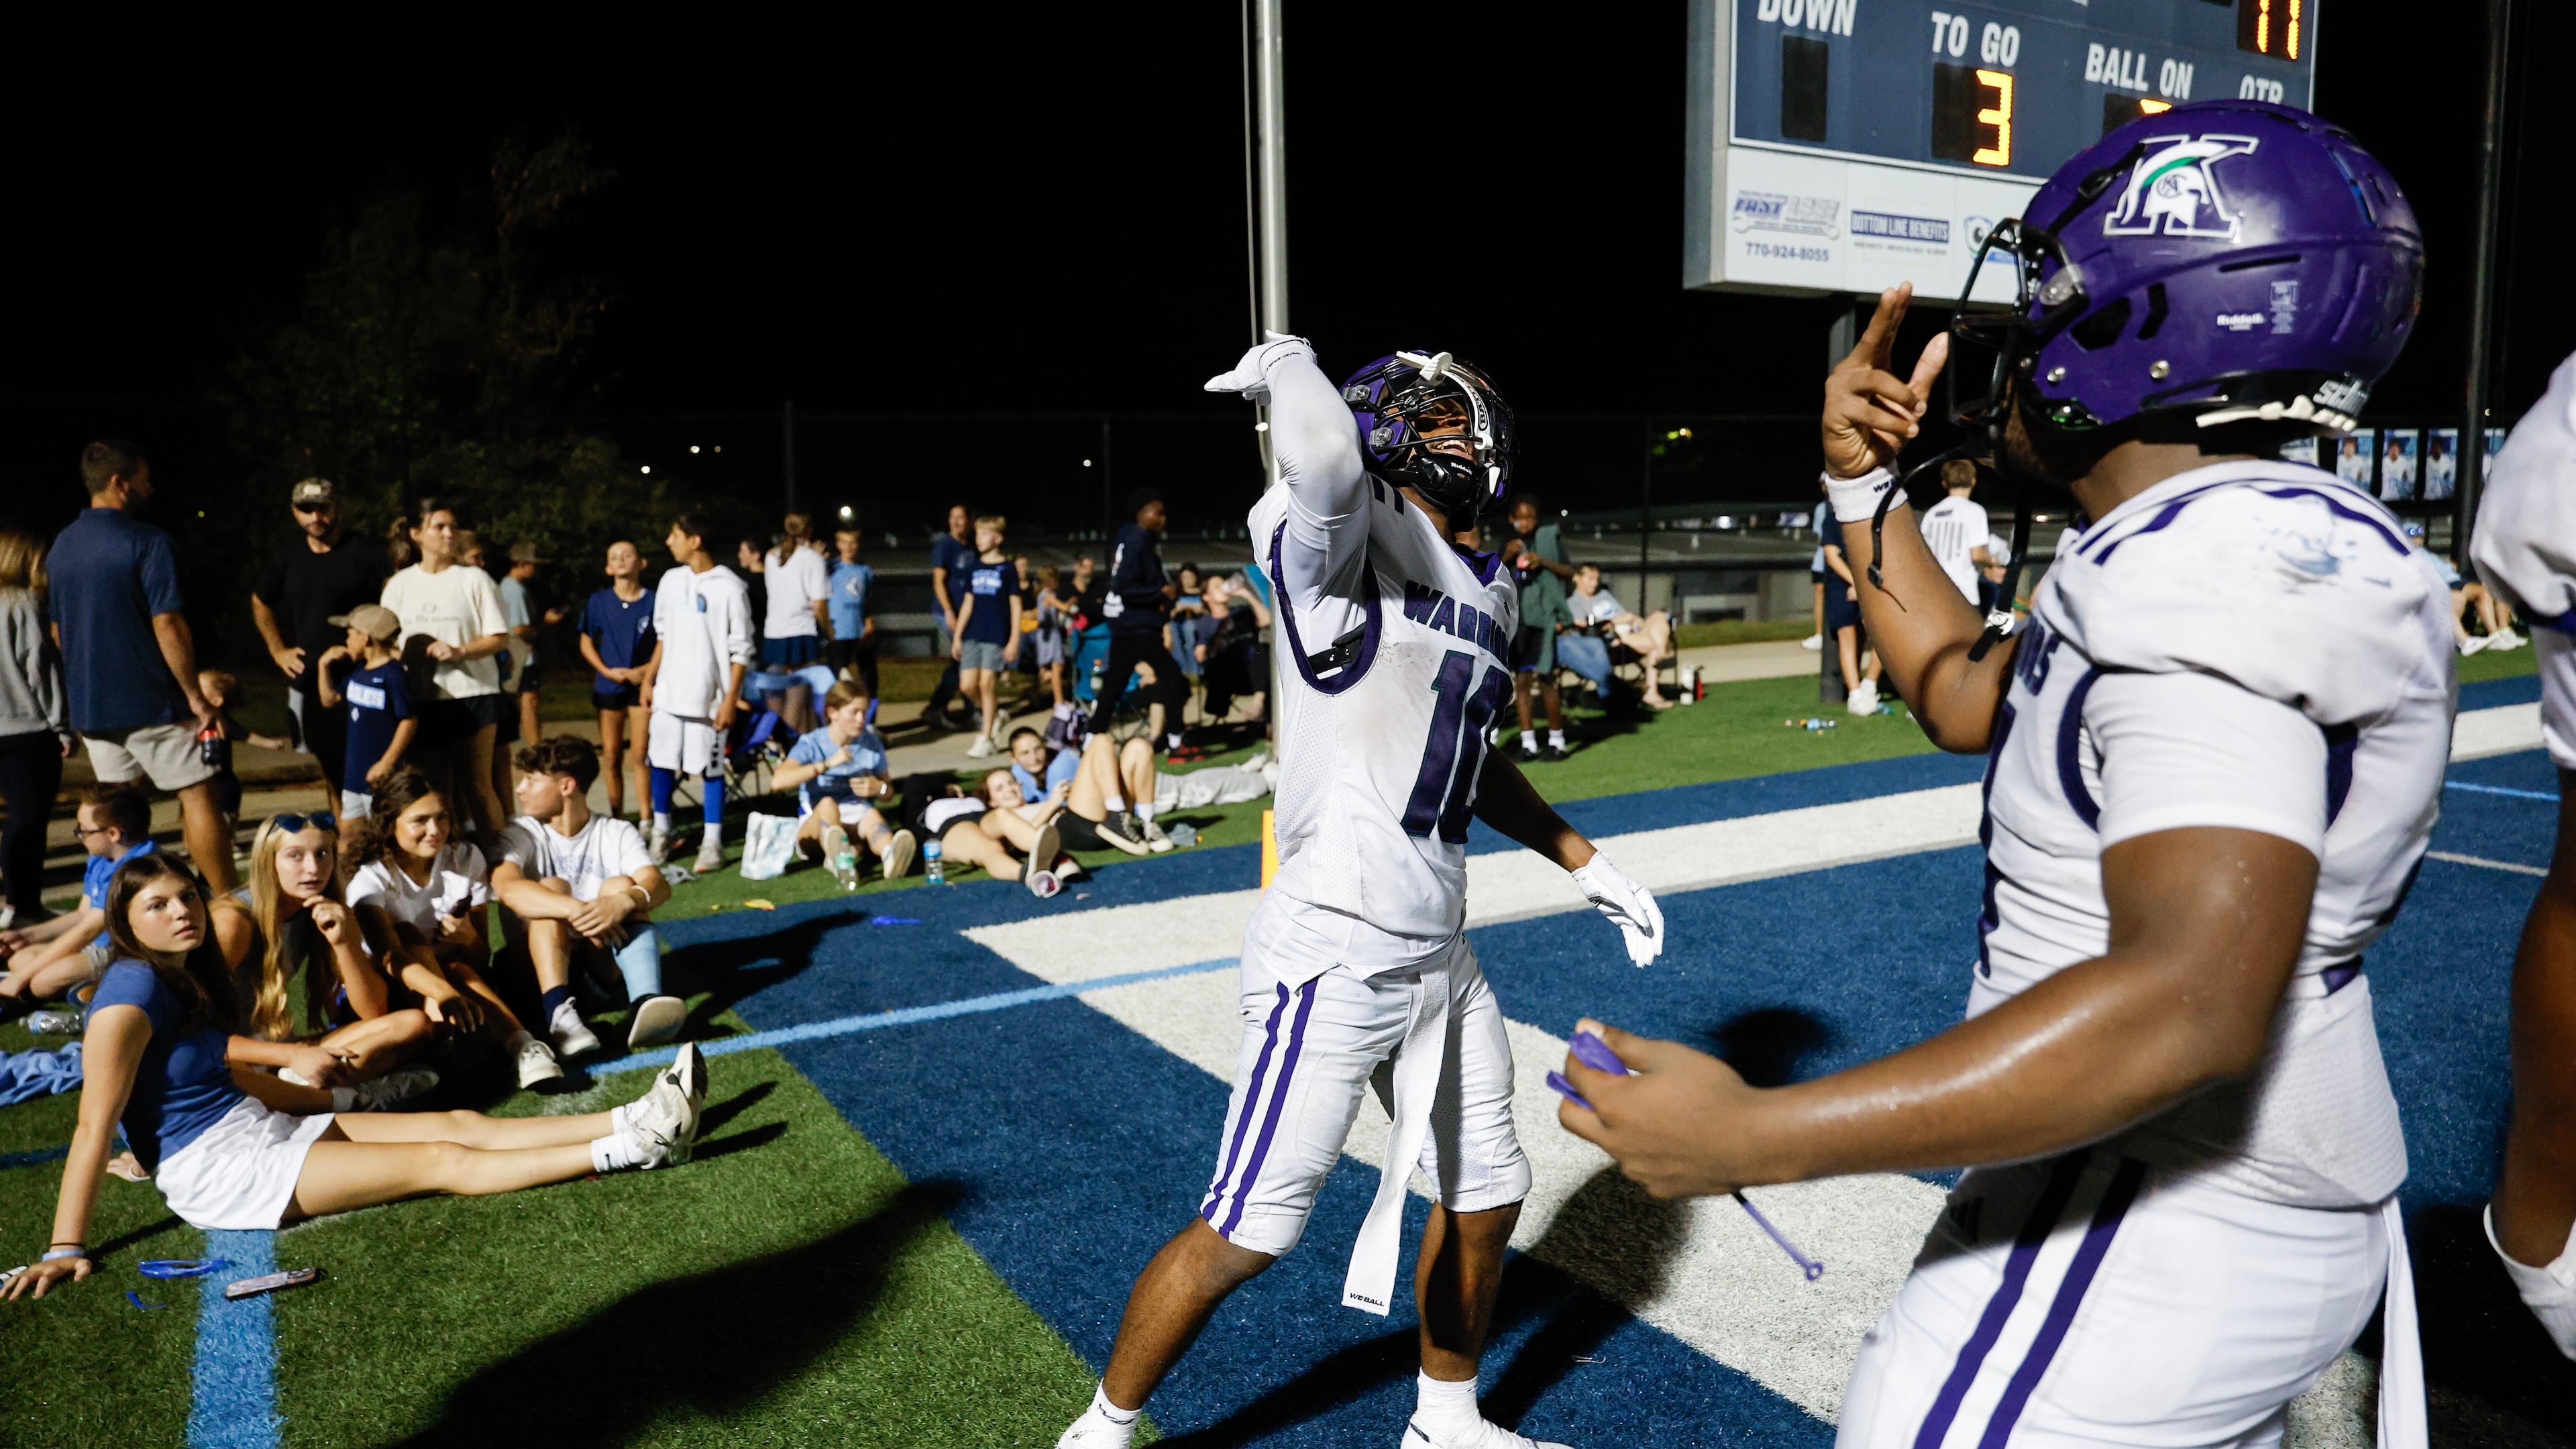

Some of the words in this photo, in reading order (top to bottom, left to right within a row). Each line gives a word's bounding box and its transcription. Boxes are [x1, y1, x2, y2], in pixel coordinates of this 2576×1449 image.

[1931, 11, 1970, 58] TO
[1980, 21, 2021, 67] GO
[2084, 42, 2149, 92] BALL
[2159, 58, 2194, 99] ON
[1973, 68, 2013, 166] 3
[1746, 241, 1829, 262] 770-924-8055
[1851, 212, 1887, 237] BOTTOM
[1888, 215, 1909, 239] LINE
[1909, 217, 1949, 242] BENEFITS
